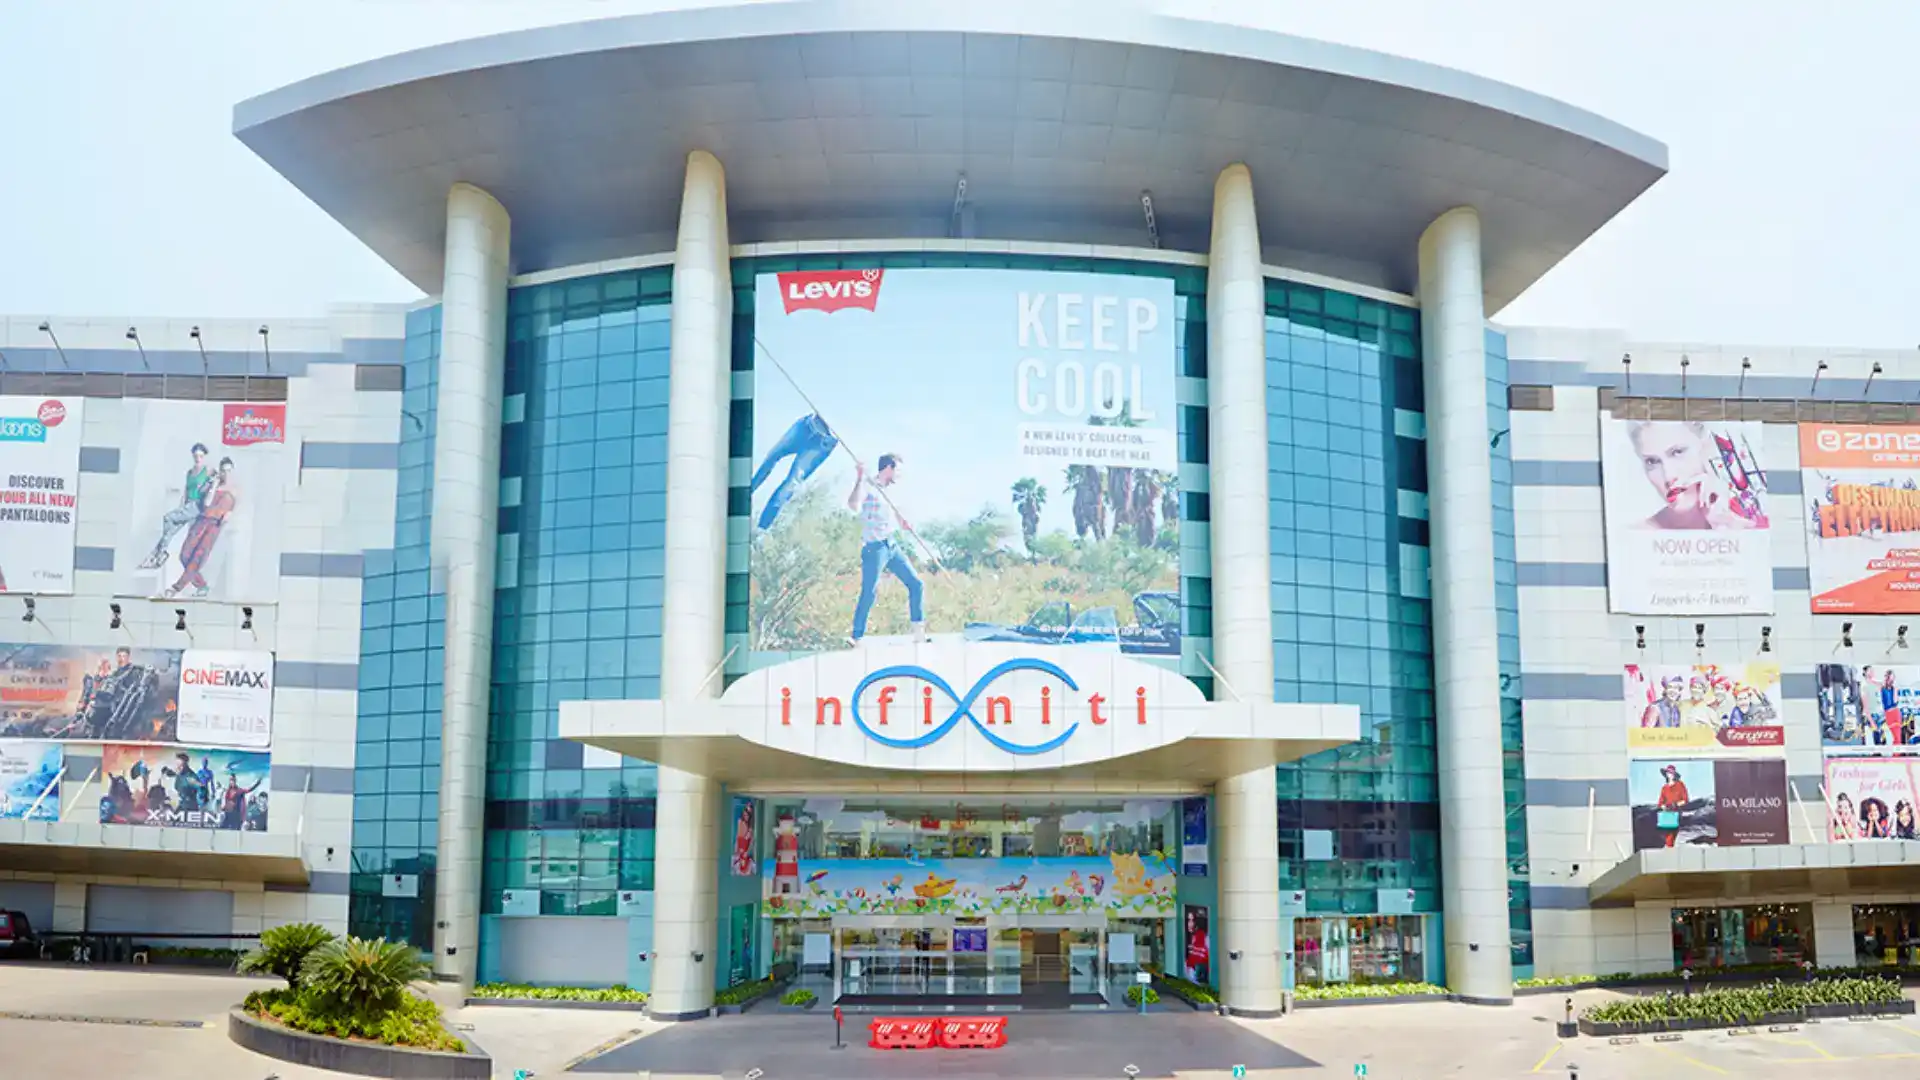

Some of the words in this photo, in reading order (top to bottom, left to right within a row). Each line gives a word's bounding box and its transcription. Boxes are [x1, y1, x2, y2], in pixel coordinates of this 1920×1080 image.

[1017, 291, 1158, 352] KEEP
[1016, 357, 1156, 420] COOL
[1033, 430, 1053, 440] NEW
[1072, 447, 1083, 458] TO
[9, 474, 65, 489] DISCOVER
[29, 491, 46, 505] ALL
[49, 493, 76, 508] NEW
[0, 508, 70, 524] PANTALOONS
[1653, 538, 1691, 555] NOW
[1696, 538, 1740, 554] OPEN
[183, 668, 265, 689] CINEMAX
[781, 685, 1148, 727] infiniti
[1722, 797, 1738, 808] DA
[1739, 796, 1781, 808] MILANO
[146, 807, 221, 823] X-MEN
